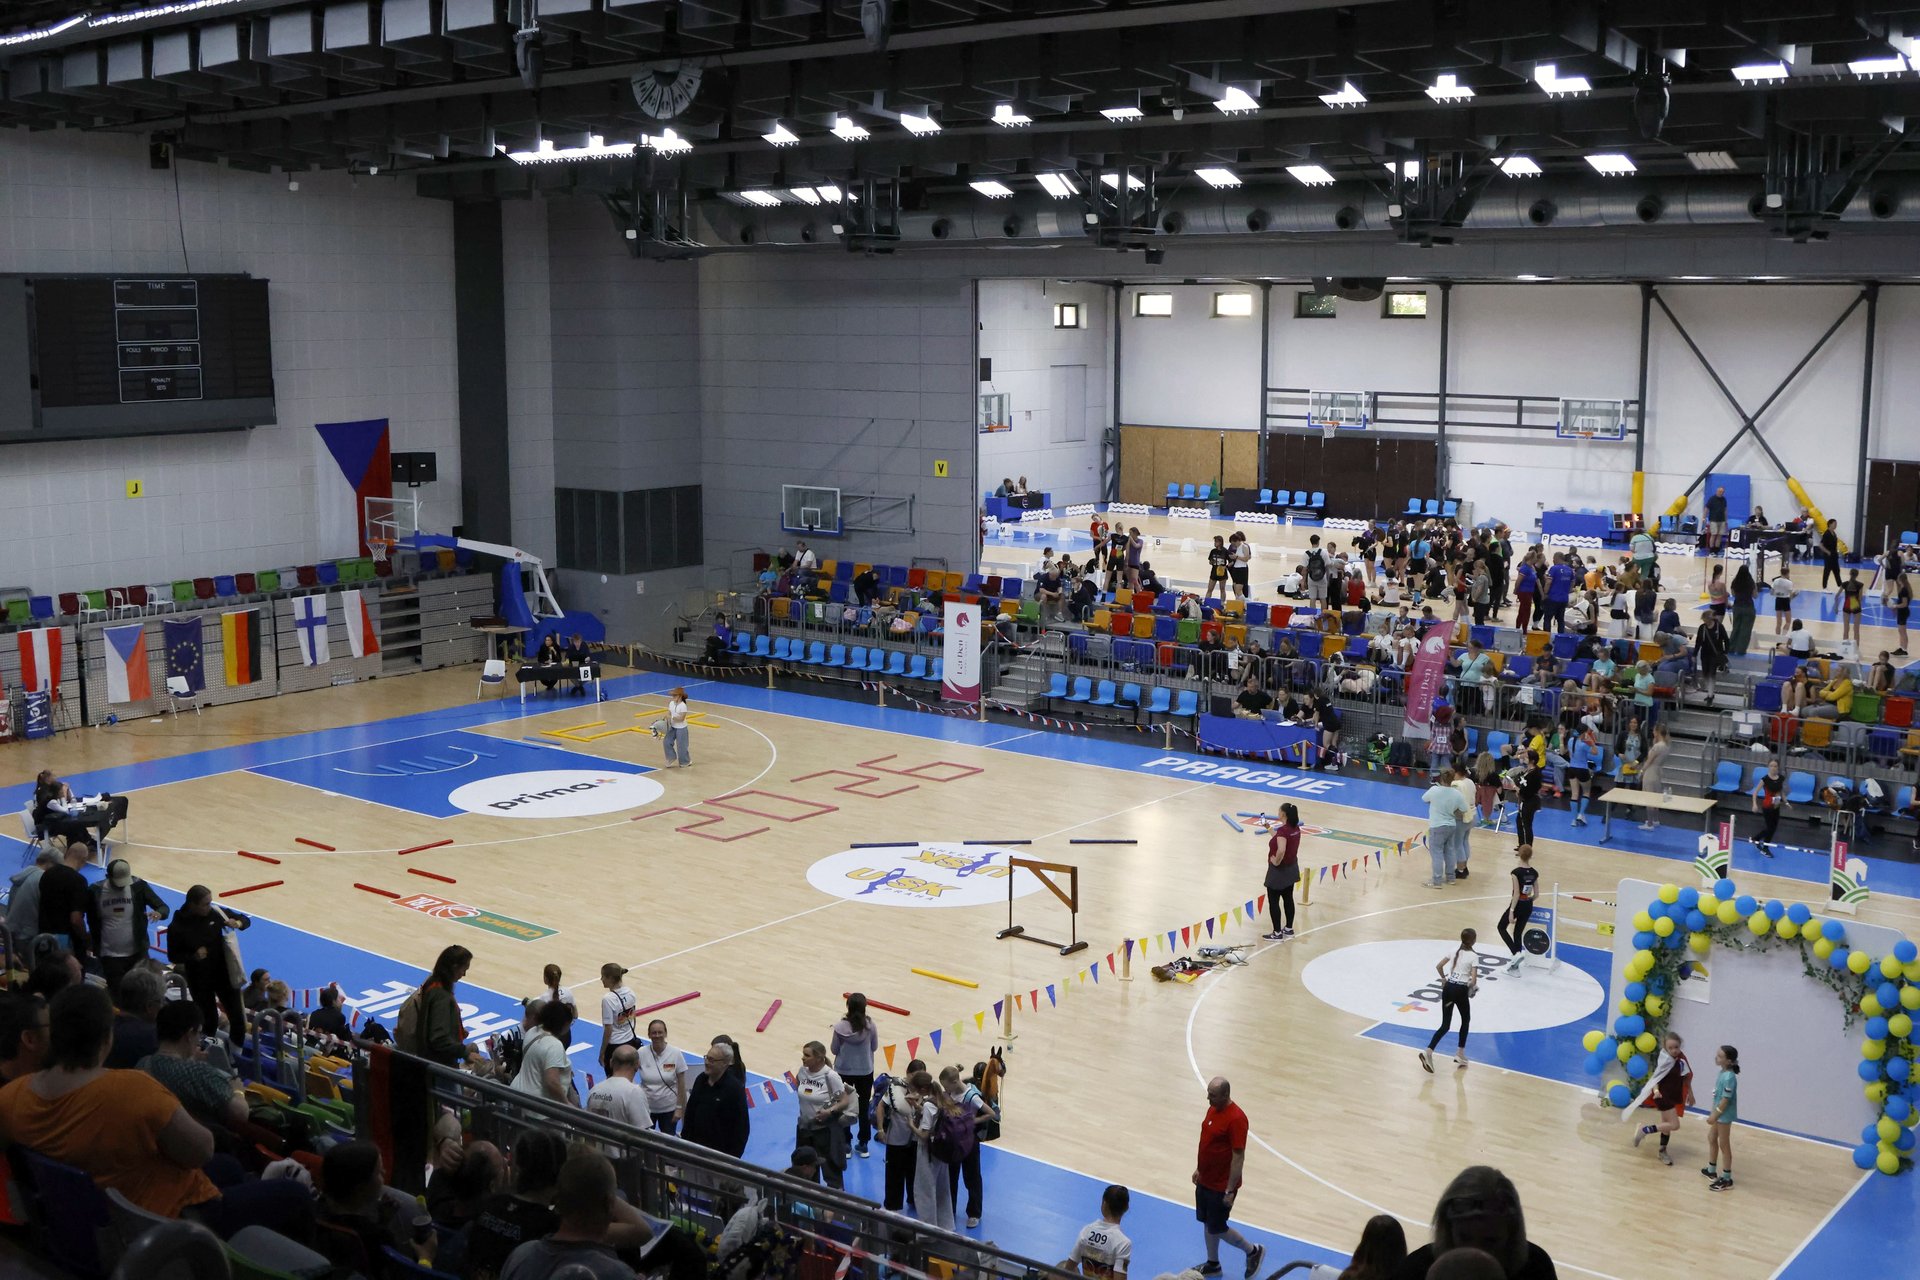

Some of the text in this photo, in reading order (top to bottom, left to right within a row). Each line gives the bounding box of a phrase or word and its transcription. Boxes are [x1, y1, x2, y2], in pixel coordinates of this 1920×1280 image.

[148, 282, 166, 290] TIME
[937, 463, 945, 474] V
[131, 482, 139, 495] J
[583, 669, 589, 679] B
[1142, 757, 1345, 795] PRAGUE
[845, 866, 963, 898] USK
[476, 915, 544, 938] Chance
[592, 1092, 613, 1101] Fanclub
[1087, 1230, 1108, 1245] 209
